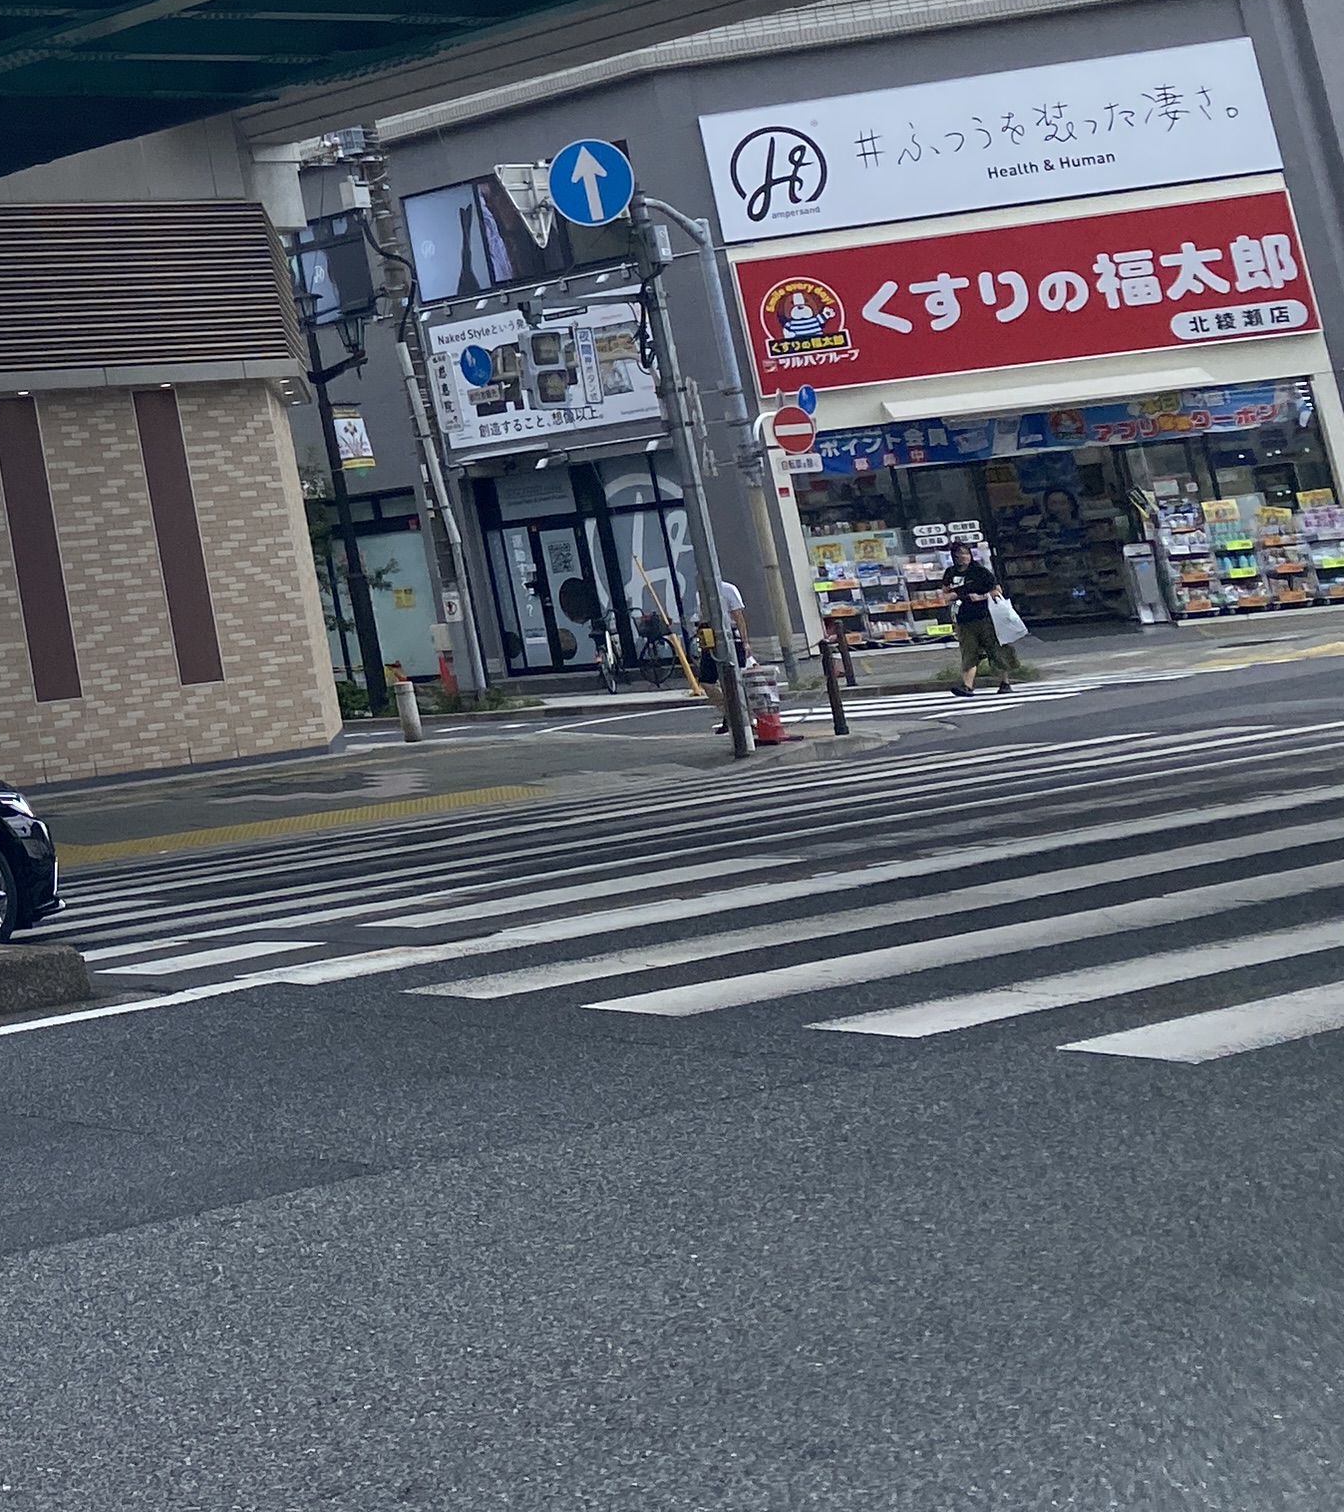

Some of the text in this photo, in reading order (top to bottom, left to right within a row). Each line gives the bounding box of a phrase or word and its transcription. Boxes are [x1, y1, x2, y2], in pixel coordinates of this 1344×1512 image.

[987, 152, 1116, 179] Health & Human
[771, 205, 821, 220] ampersand
[861, 233, 1299, 335] くすりの福太郎
[1188, 305, 1292, 335] 北綾瀬店
[437, 331, 466, 345] Naked
[771, 334, 845, 353] くすりの福太郎
[778, 349, 860, 369] ツルハグループ
[478, 408, 604, 437] 創造すること、想像以上。
